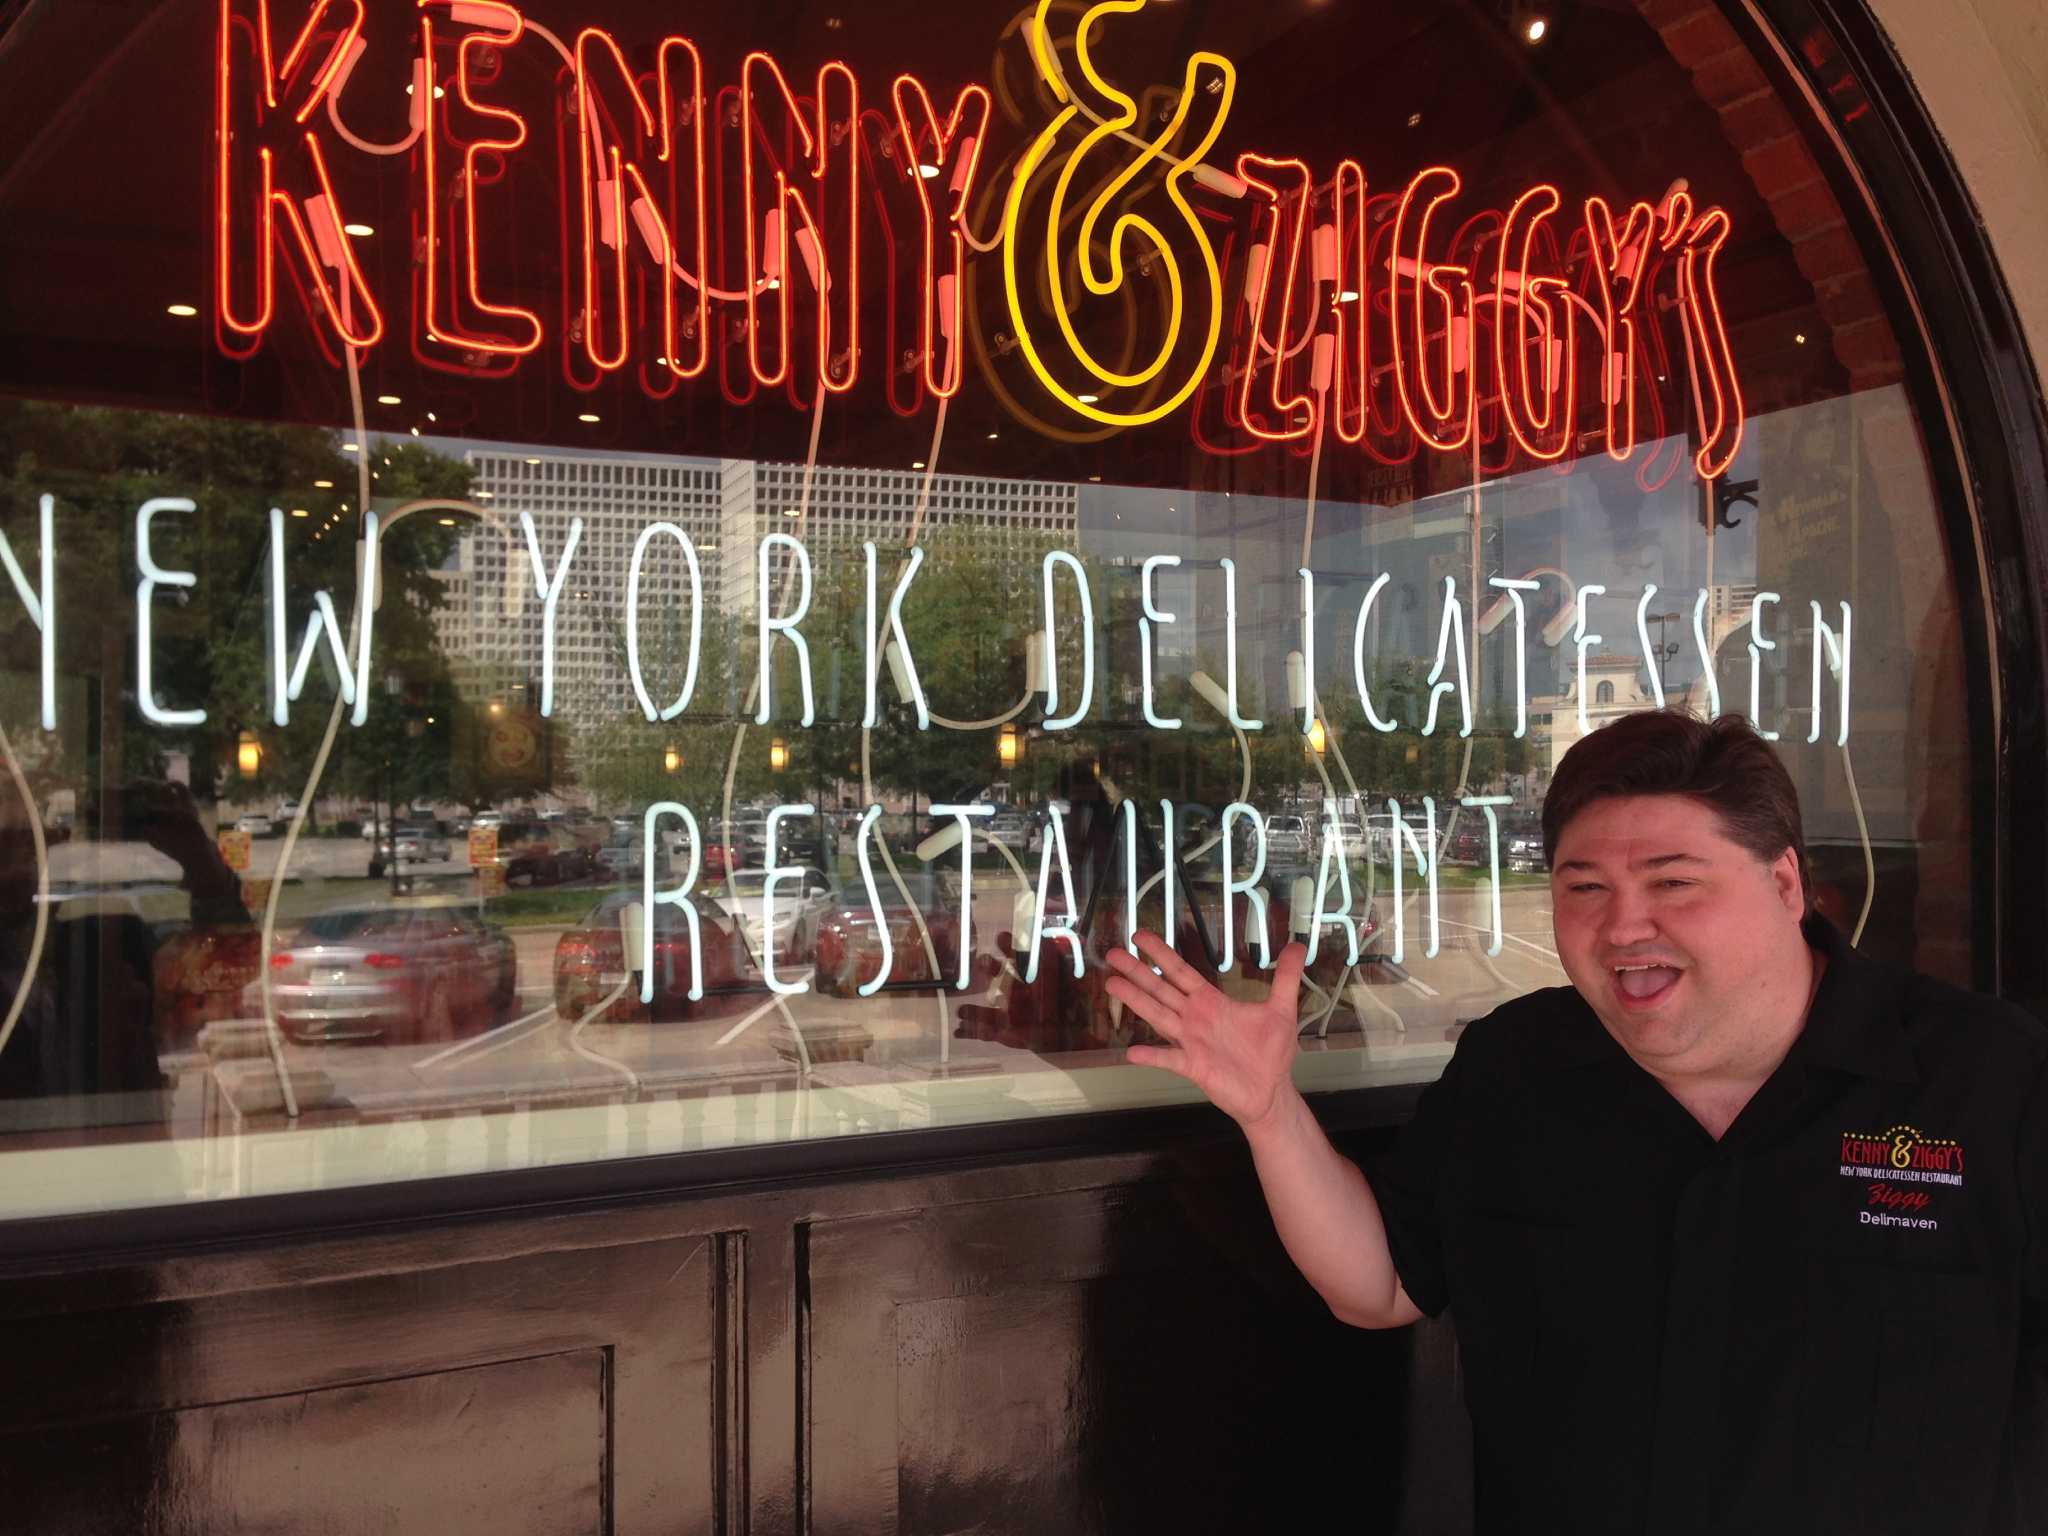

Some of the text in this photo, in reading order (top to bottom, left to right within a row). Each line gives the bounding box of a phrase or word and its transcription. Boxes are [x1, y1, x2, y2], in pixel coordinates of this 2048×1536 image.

[217, 0, 1745, 480] KENNY & ZIGGY'S
[0, 493, 1854, 746] NEW YORK DELICATESSEN
[640, 796, 1514, 1004] RESTAURANT
[1840, 1135, 1965, 1173] KENNY & ZIGGY'S
[1840, 1166, 1962, 1186] NEW YORK DELICATESSEN RESTAURANT
[1867, 1183, 1932, 1210] Ziggy
[1860, 1211, 1938, 1230] Delimaven
